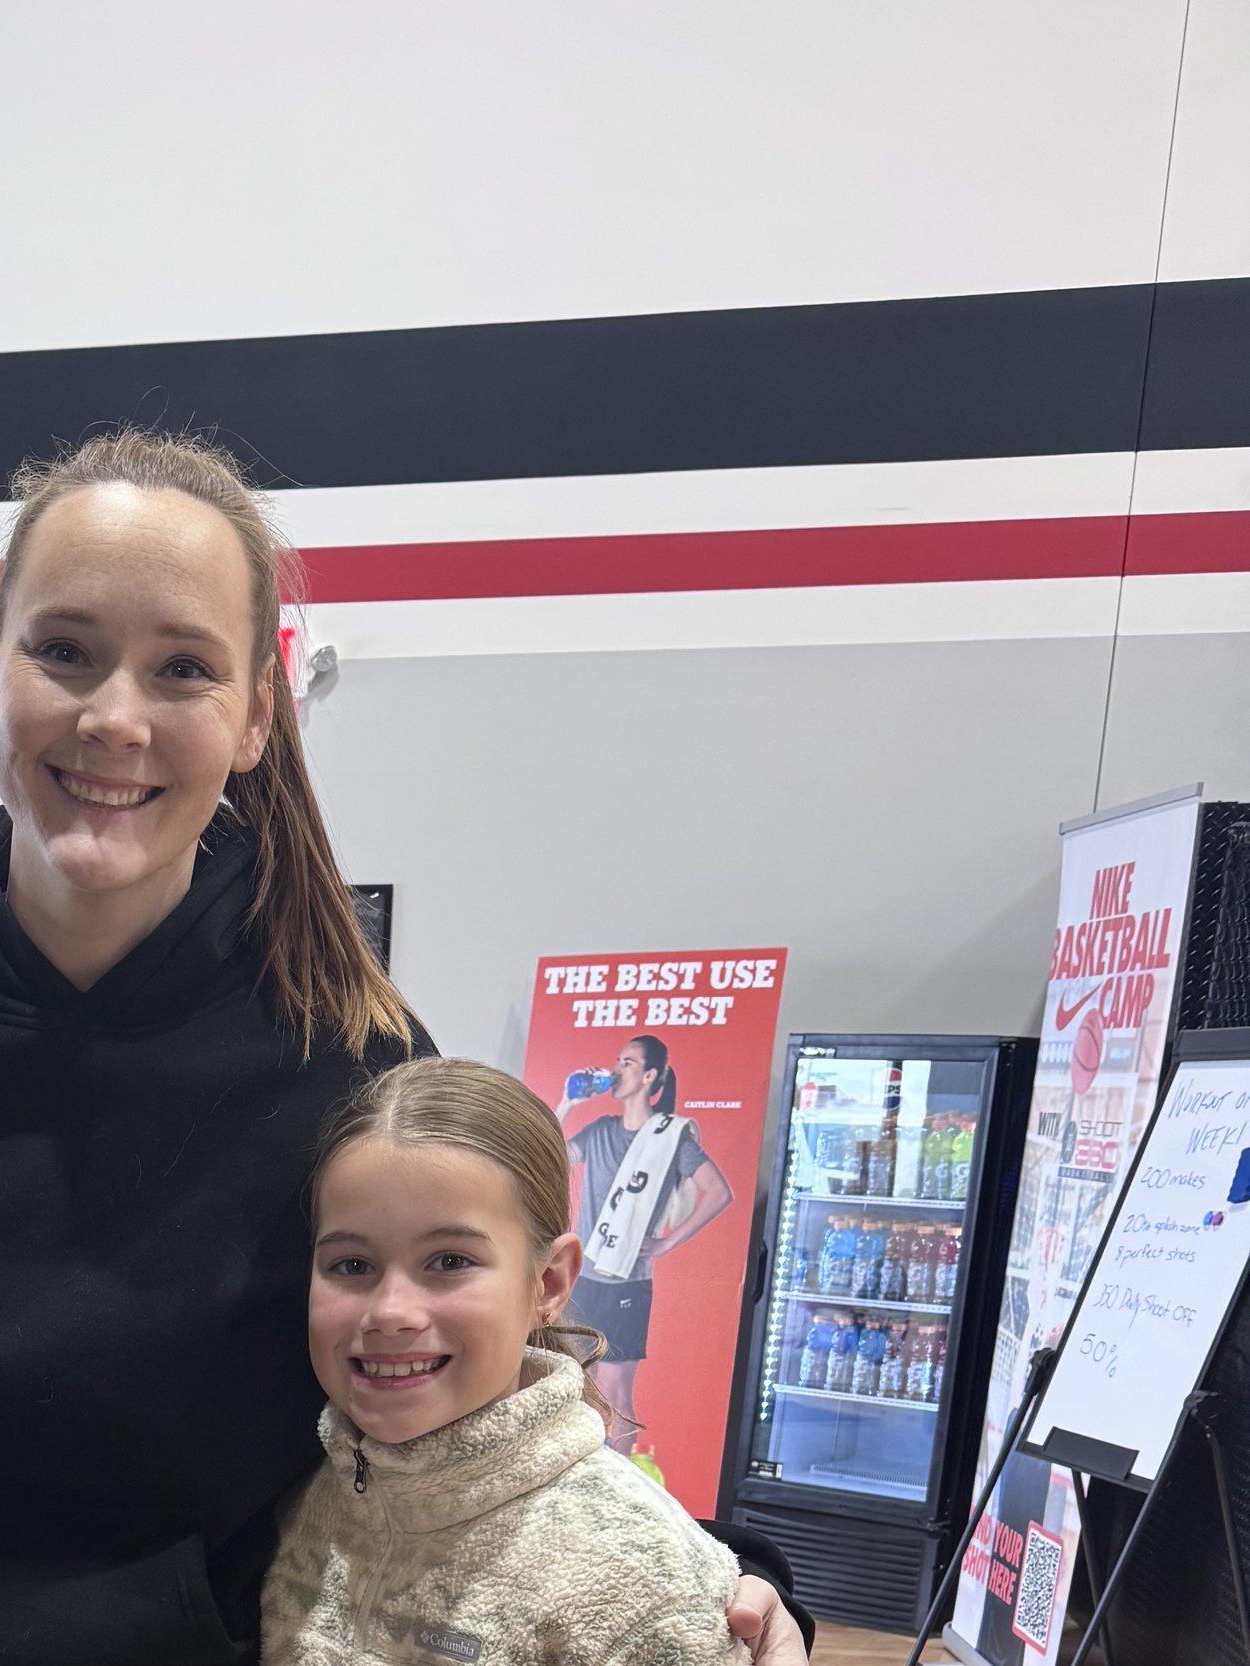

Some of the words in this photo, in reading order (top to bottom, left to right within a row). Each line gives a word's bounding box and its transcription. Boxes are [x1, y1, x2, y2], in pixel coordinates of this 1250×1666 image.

[1089, 861, 1136, 921] NIKE
[1049, 908, 1172, 982] BASKETBALL
[544, 964, 610, 995] THE
[614, 962, 703, 992] BEST
[709, 959, 778, 990] USE
[1101, 973, 1155, 1030] CAMP
[571, 998, 640, 1029] THE
[643, 996, 735, 1027] BEST
[1079, 1332, 1119, 1378] 50%
[993, 1519, 1024, 1569] YOUR
[962, 1543, 991, 1585] SHOT
[988, 1558, 1017, 1606] HERE
[430, 1632, 474, 1657] Columbia
